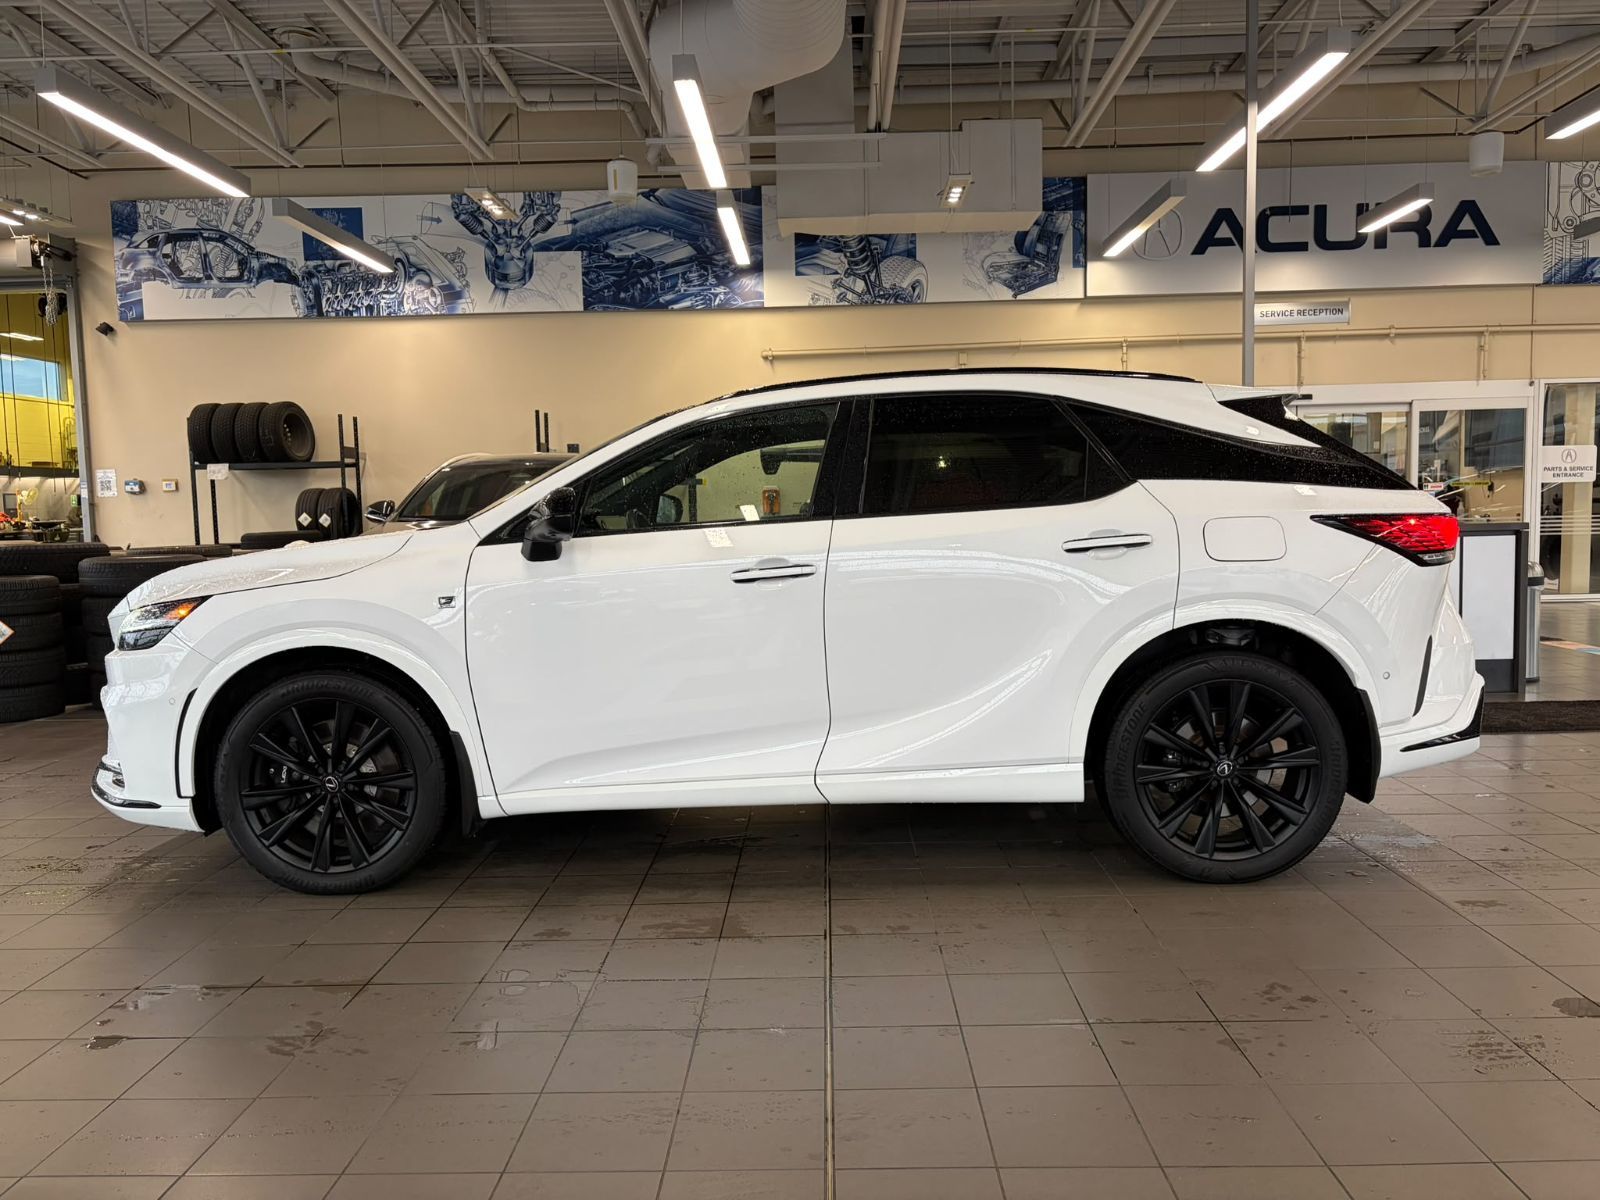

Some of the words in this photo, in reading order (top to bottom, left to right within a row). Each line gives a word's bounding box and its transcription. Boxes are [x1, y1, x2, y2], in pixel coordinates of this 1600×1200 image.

[1191, 200, 1500, 255] ACURA
[1260, 309, 1295, 318] SERVICE
[1296, 307, 1344, 317] RECEPTION
